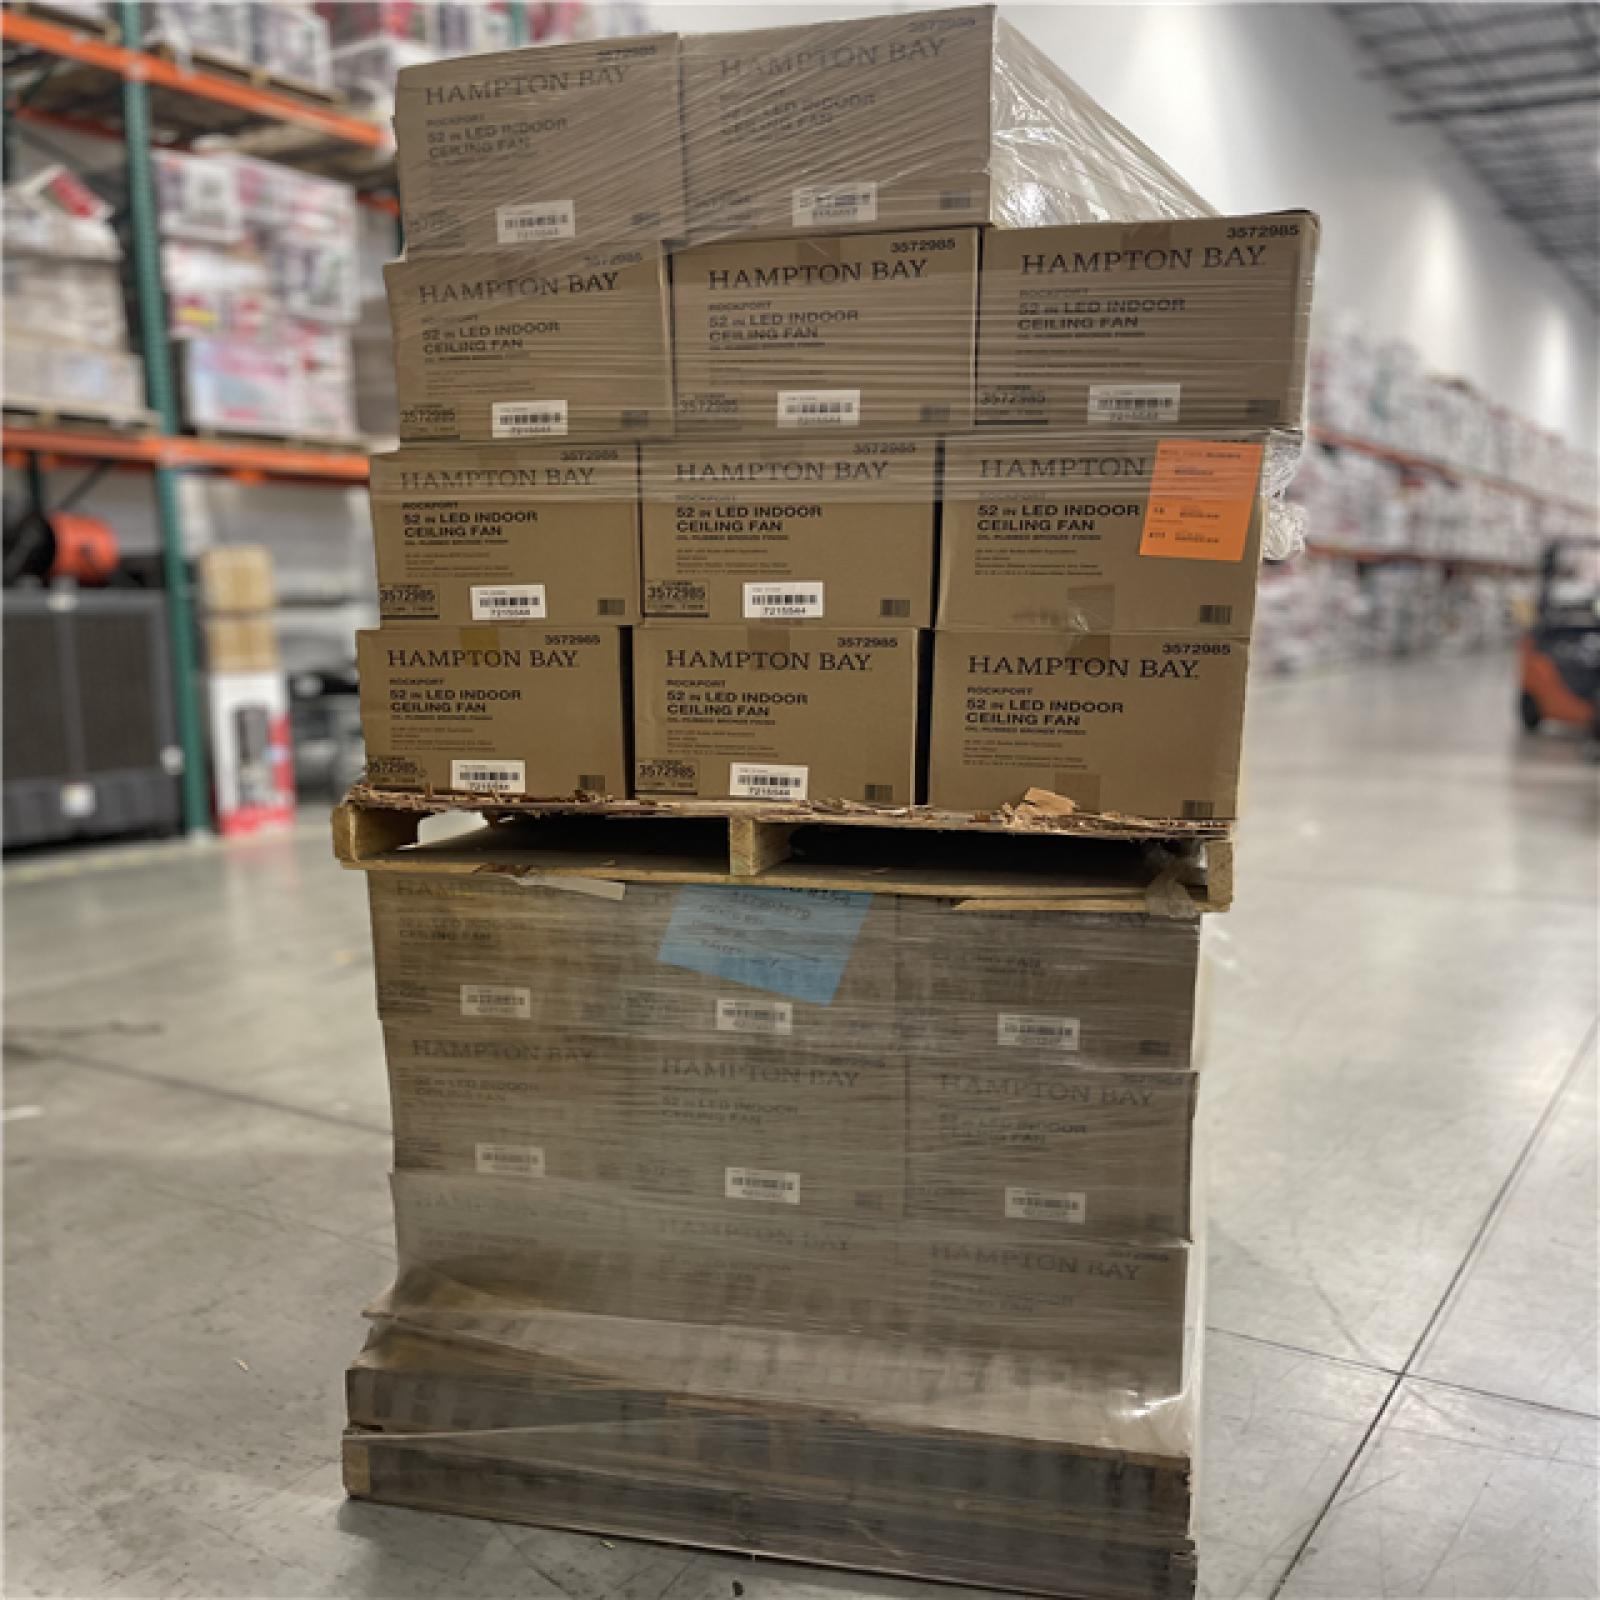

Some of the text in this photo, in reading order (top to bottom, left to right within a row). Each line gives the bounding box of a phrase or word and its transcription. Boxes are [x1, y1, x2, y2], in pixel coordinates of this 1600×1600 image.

[888, 38, 945, 64] BAY
[426, 65, 630, 105] HAMPTON BAY
[1227, 225, 1298, 239] 3572985
[890, 239, 956, 252] 3572985
[1021, 245, 1266, 275] HAMPTON BAY
[709, 259, 928, 289] HAMPTON BAY
[419, 272, 618, 304] HAMPTON BAY
[1064, 302, 1099, 314] LED
[1106, 298, 1185, 312] INDOOR
[709, 314, 728, 327] 52
[750, 312, 783, 326] LED
[789, 310, 859, 323] INDOOR
[1018, 316, 1137, 330] CEILING FAN
[460, 325, 490, 338] LED
[495, 321, 560, 336] INDOOR
[709, 327, 818, 342] CEILING FAN
[423, 338, 523, 355] CEILING FAN
[677, 460, 888, 481] HAMPTON BAY
[980, 457, 1145, 478] HAMPTON
[401, 467, 594, 490] HAMPTON BAY
[676, 506, 694, 518] 52
[716, 506, 748, 518] LED
[754, 504, 822, 518] INDOOR
[977, 505, 998, 516] 52
[1022, 504, 1058, 516] LED
[1064, 504, 1140, 516] INDOOR
[404, 514, 420, 525] 52
[439, 512, 470, 524] LED
[474, 511, 538, 523] INDOOR
[977, 519, 1095, 531] CEILING FAN
[404, 525, 502, 538] CEILING FAN
[676, 520, 783, 532] CEILING FAN
[838, 637, 898, 648] 3572985
[1162, 643, 1231, 655] 3572985
[388, 649, 521, 668] HAMPTON
[666, 649, 810, 671] HAMPTON
[968, 655, 1129, 678] HAMPTON
[390, 690, 406, 700] 52
[426, 690, 455, 700] LED
[460, 690, 521, 700] INDOOR
[667, 690, 685, 702] 52
[705, 691, 737, 703] LED
[742, 692, 808, 705] INDOOR
[967, 687, 1033, 695] ROCKPORT
[391, 702, 486, 713] CEILING FAN
[667, 704, 769, 716] CEILING FAN
[967, 699, 986, 711] 52
[1009, 700, 1044, 712] LED
[1050, 701, 1123, 714] INDOOR
[966, 712, 1080, 726] CEILING FAN
[662, 1056, 799, 1082] HAMPTON
